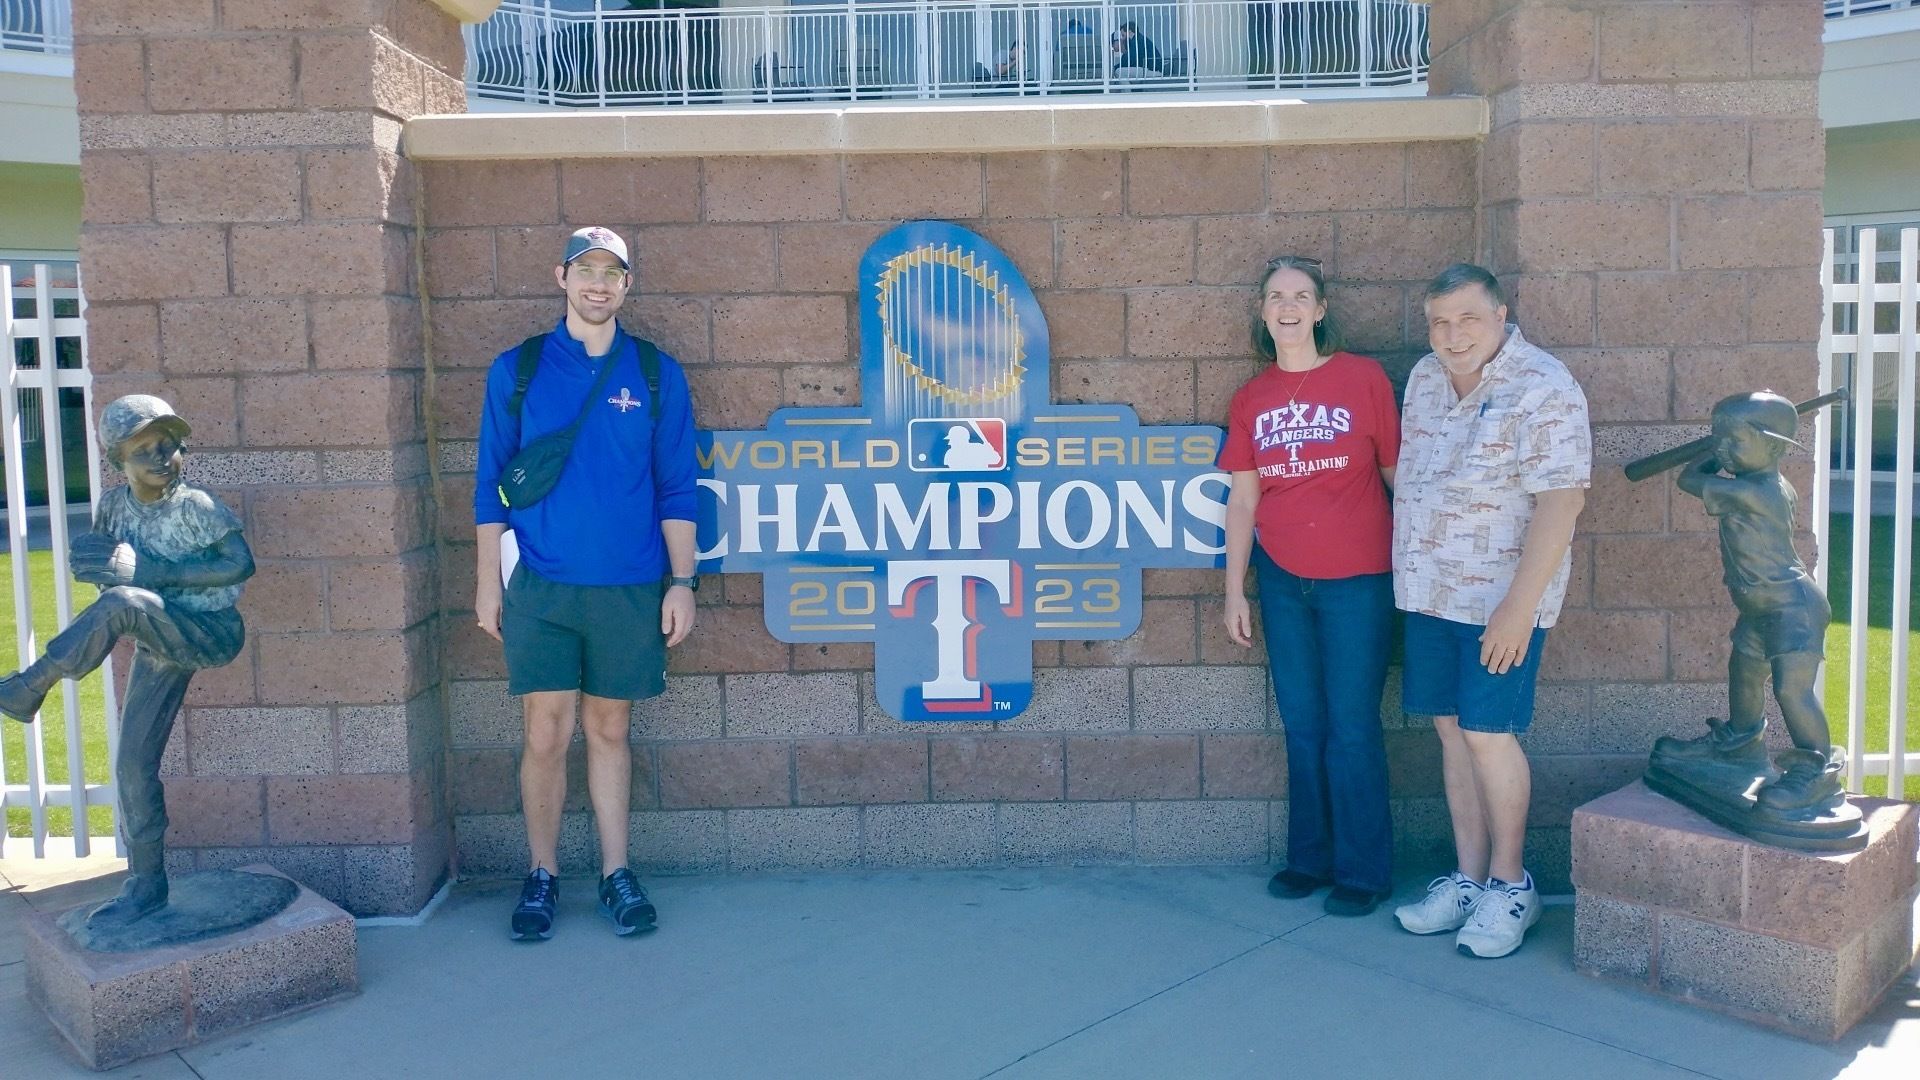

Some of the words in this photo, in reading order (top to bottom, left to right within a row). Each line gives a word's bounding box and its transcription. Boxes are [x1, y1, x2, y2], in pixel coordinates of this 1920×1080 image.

[1255, 404, 1350, 440] TEXAS
[696, 440, 899, 469] WORLD
[1016, 436, 1216, 466] SERIES
[1261, 428, 1334, 450] RANGERS
[1286, 442, 1303, 462] T
[1258, 465, 1286, 478] PRING
[1289, 456, 1349, 473] TRAINING
[789, 580, 876, 616] 20
[1035, 578, 1120, 613] 23
[888, 560, 1022, 712] T
[993, 701, 1011, 711] TM
